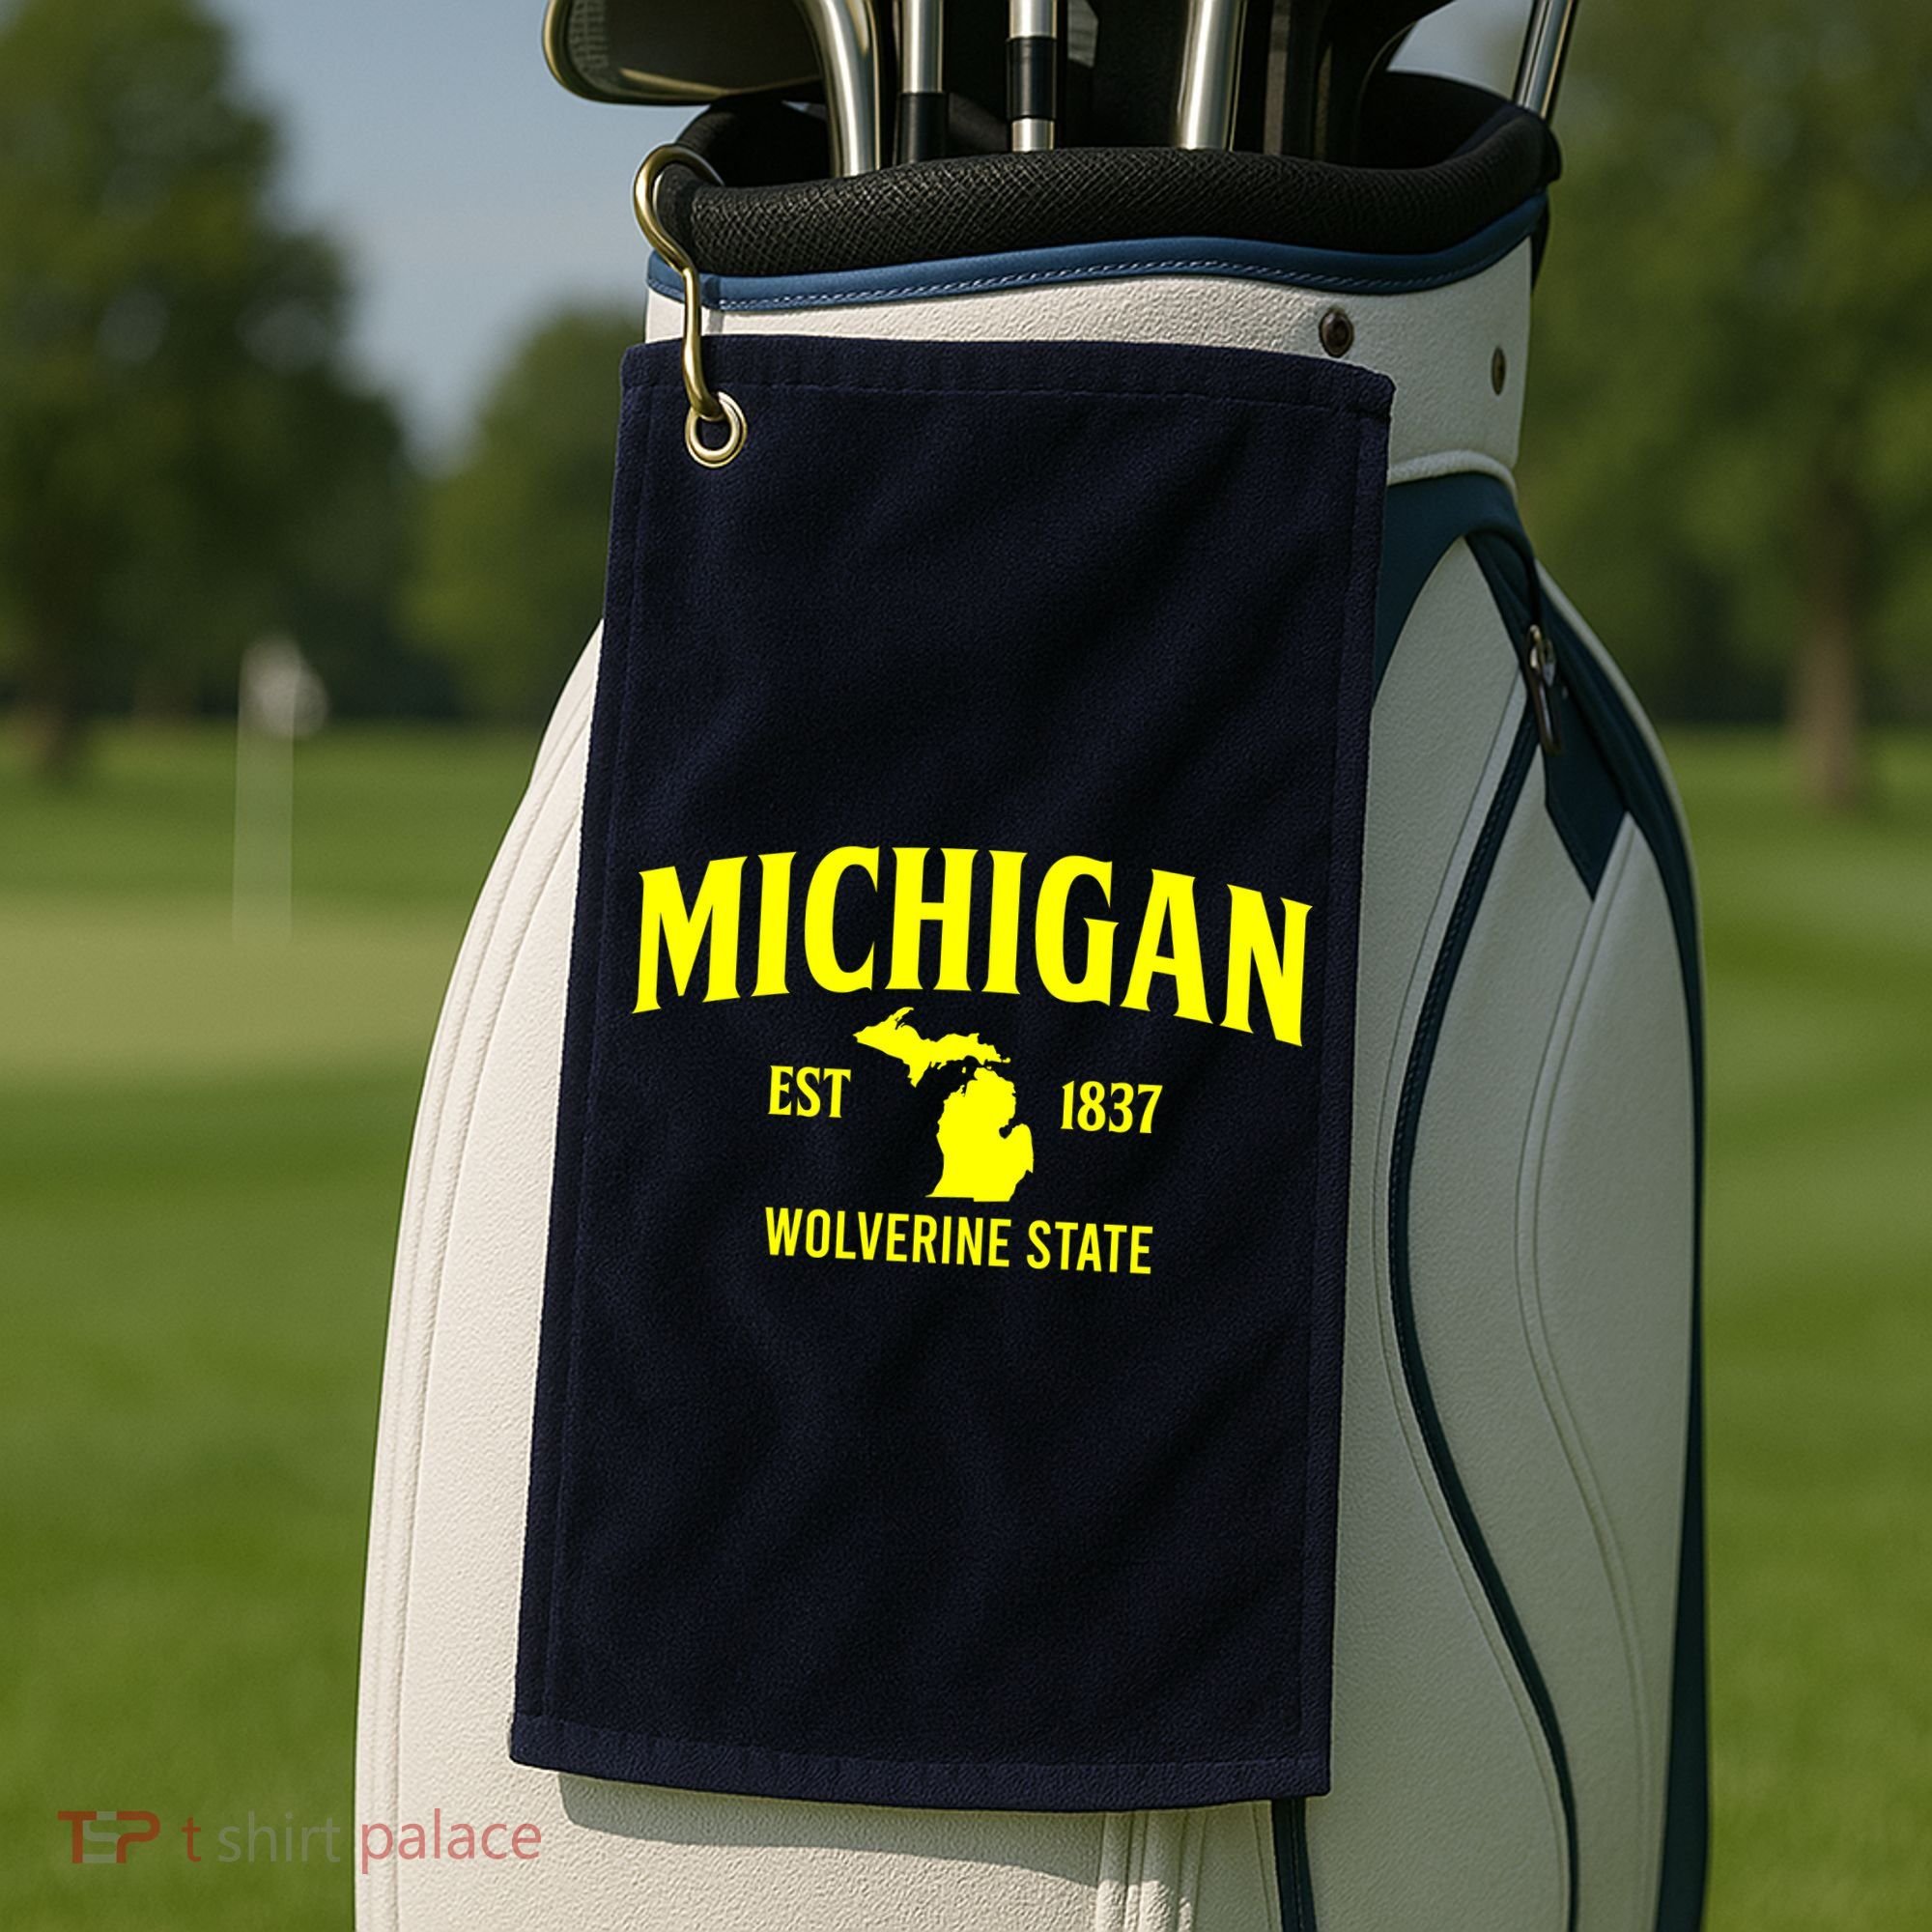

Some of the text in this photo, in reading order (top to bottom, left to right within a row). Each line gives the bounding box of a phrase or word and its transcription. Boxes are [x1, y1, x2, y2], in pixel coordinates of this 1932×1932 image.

[633, 845, 1313, 1047] MICHIGAN
[768, 1065, 1163, 1134] EST 1837
[765, 1207, 1153, 1274] WOLVERINE STATE
